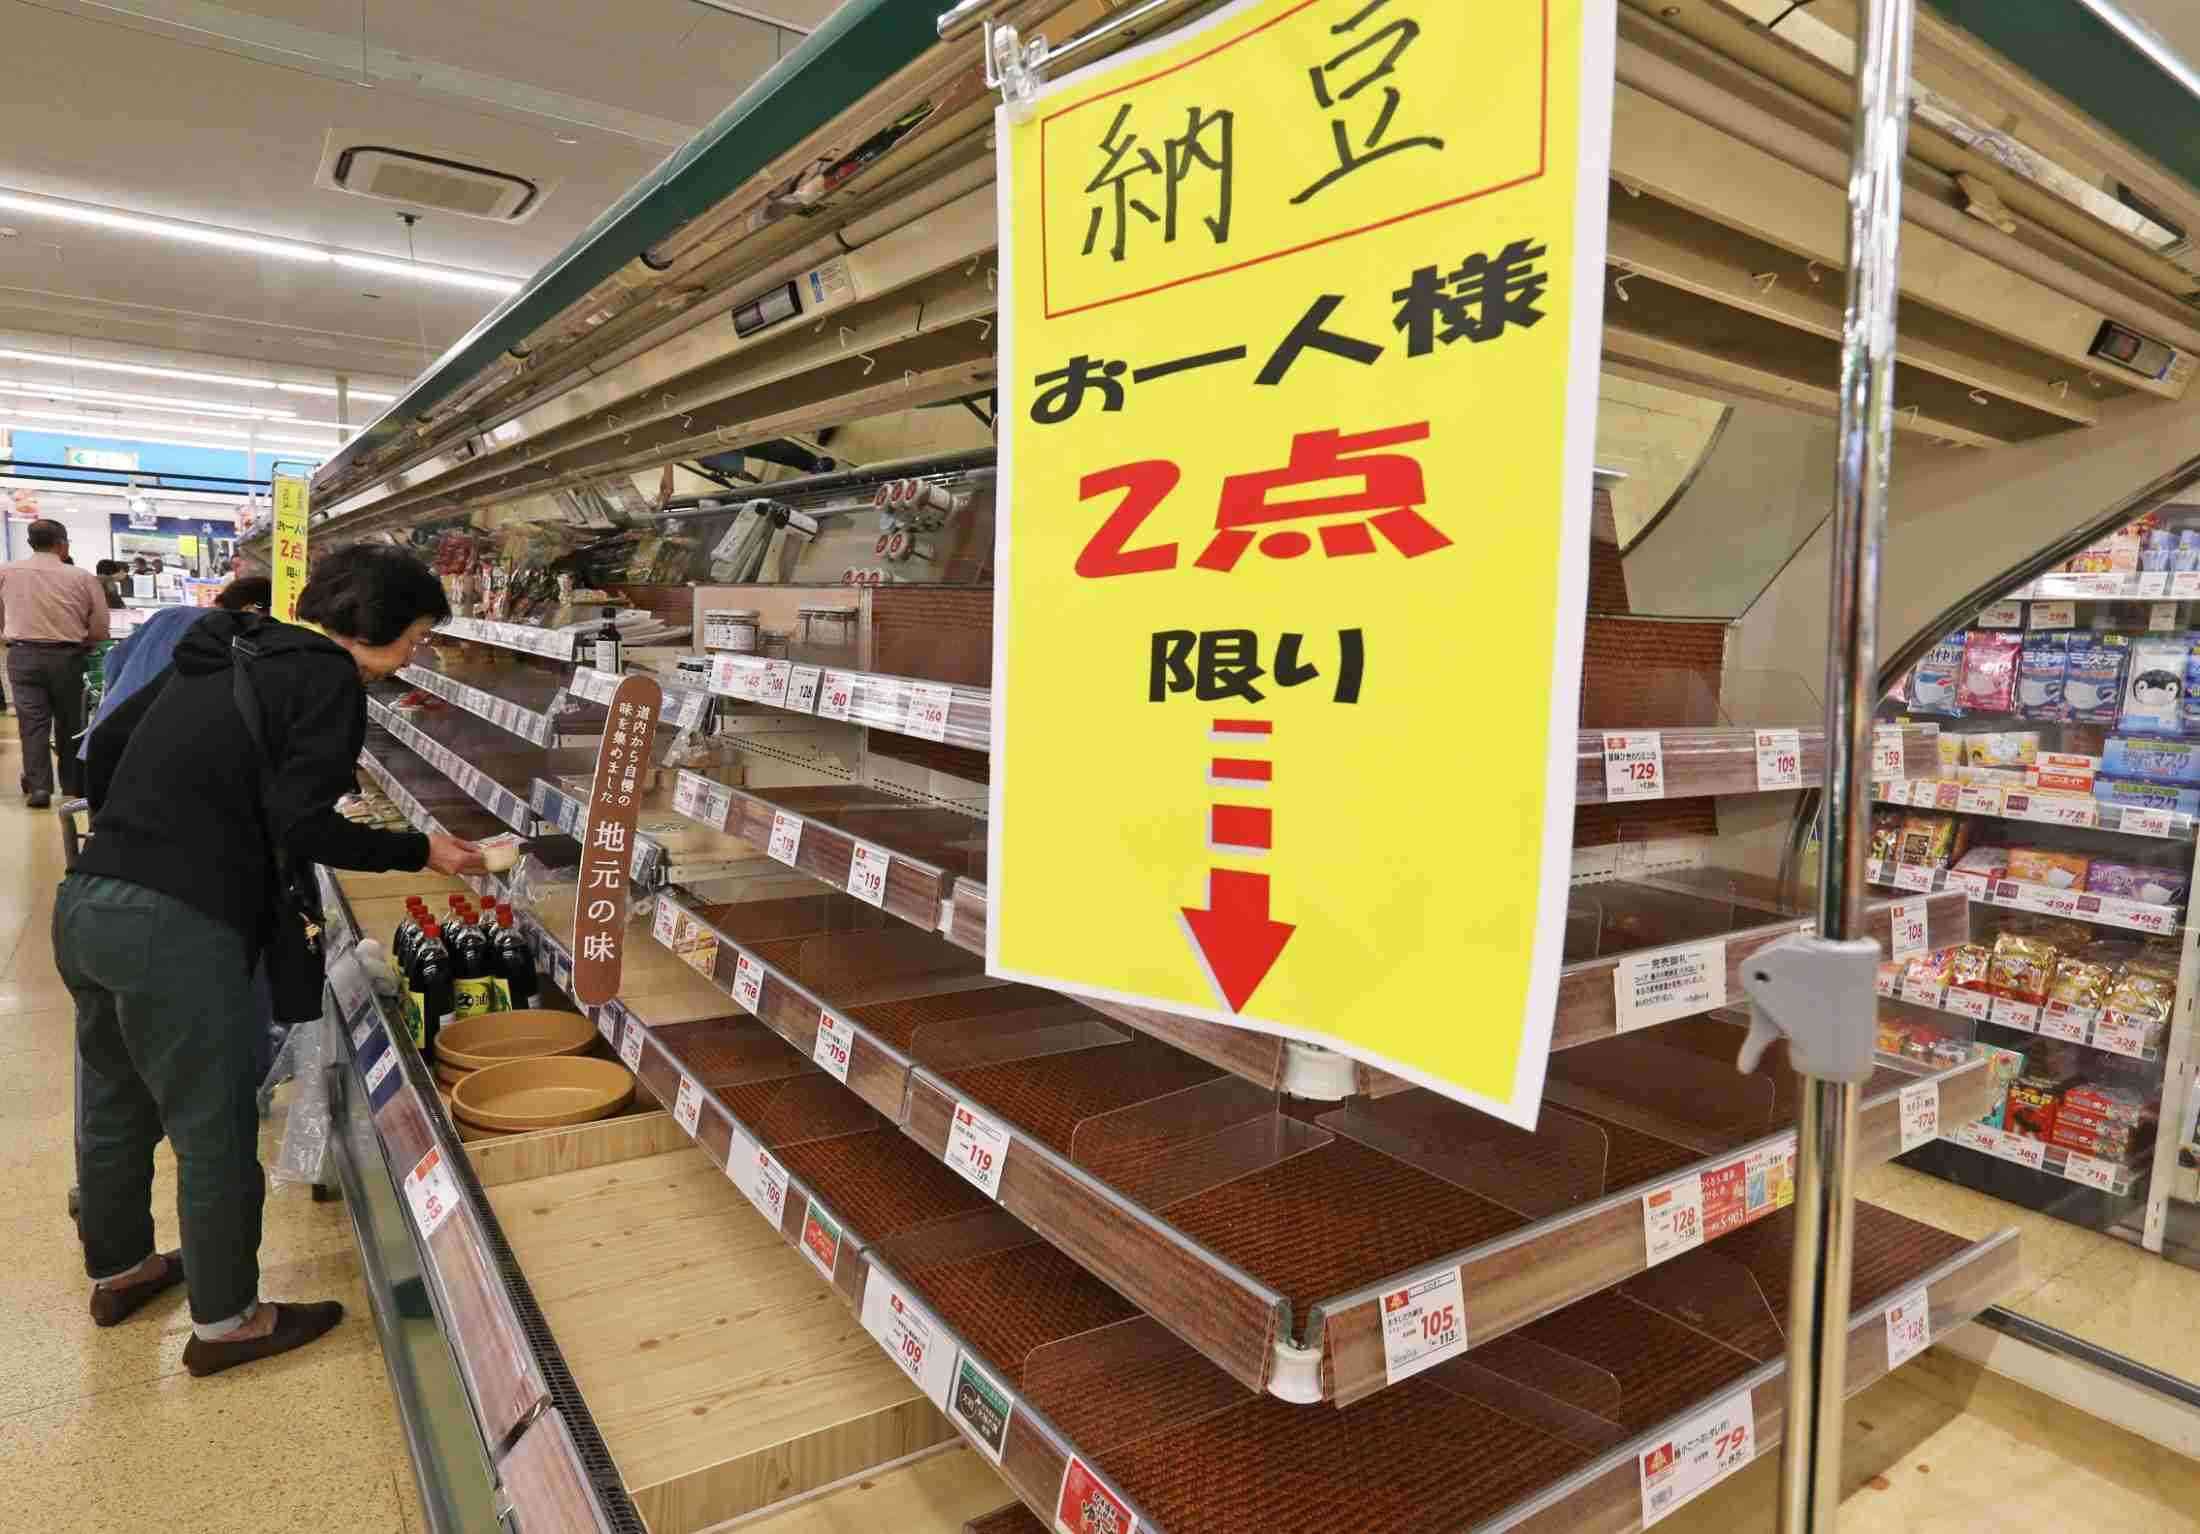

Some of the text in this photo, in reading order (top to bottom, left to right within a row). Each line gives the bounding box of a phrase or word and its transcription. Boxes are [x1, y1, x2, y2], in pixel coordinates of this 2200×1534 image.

[1082, 0, 1445, 262] 納豆
[1029, 237, 1549, 424] お一人様
[1073, 419, 1455, 579] 2点
[1148, 627, 1366, 705] 限り
[599, 701, 633, 804] 味を集めました
[616, 701, 651, 808] 道内から自慢の
[1777, 755, 1796, 773] 109
[1884, 750, 1900, 769] 159
[1629, 762, 1657, 781] 129
[582, 819, 626, 963] 地元の味
[863, 871, 881, 890] 119
[828, 1042, 848, 1065] 119
[969, 1143, 993, 1171] 119
[1672, 1206, 1697, 1234] 128
[1420, 1303, 1454, 1340] 105
[901, 1332, 923, 1364] 109
[1714, 1424, 1745, 1459] 79
